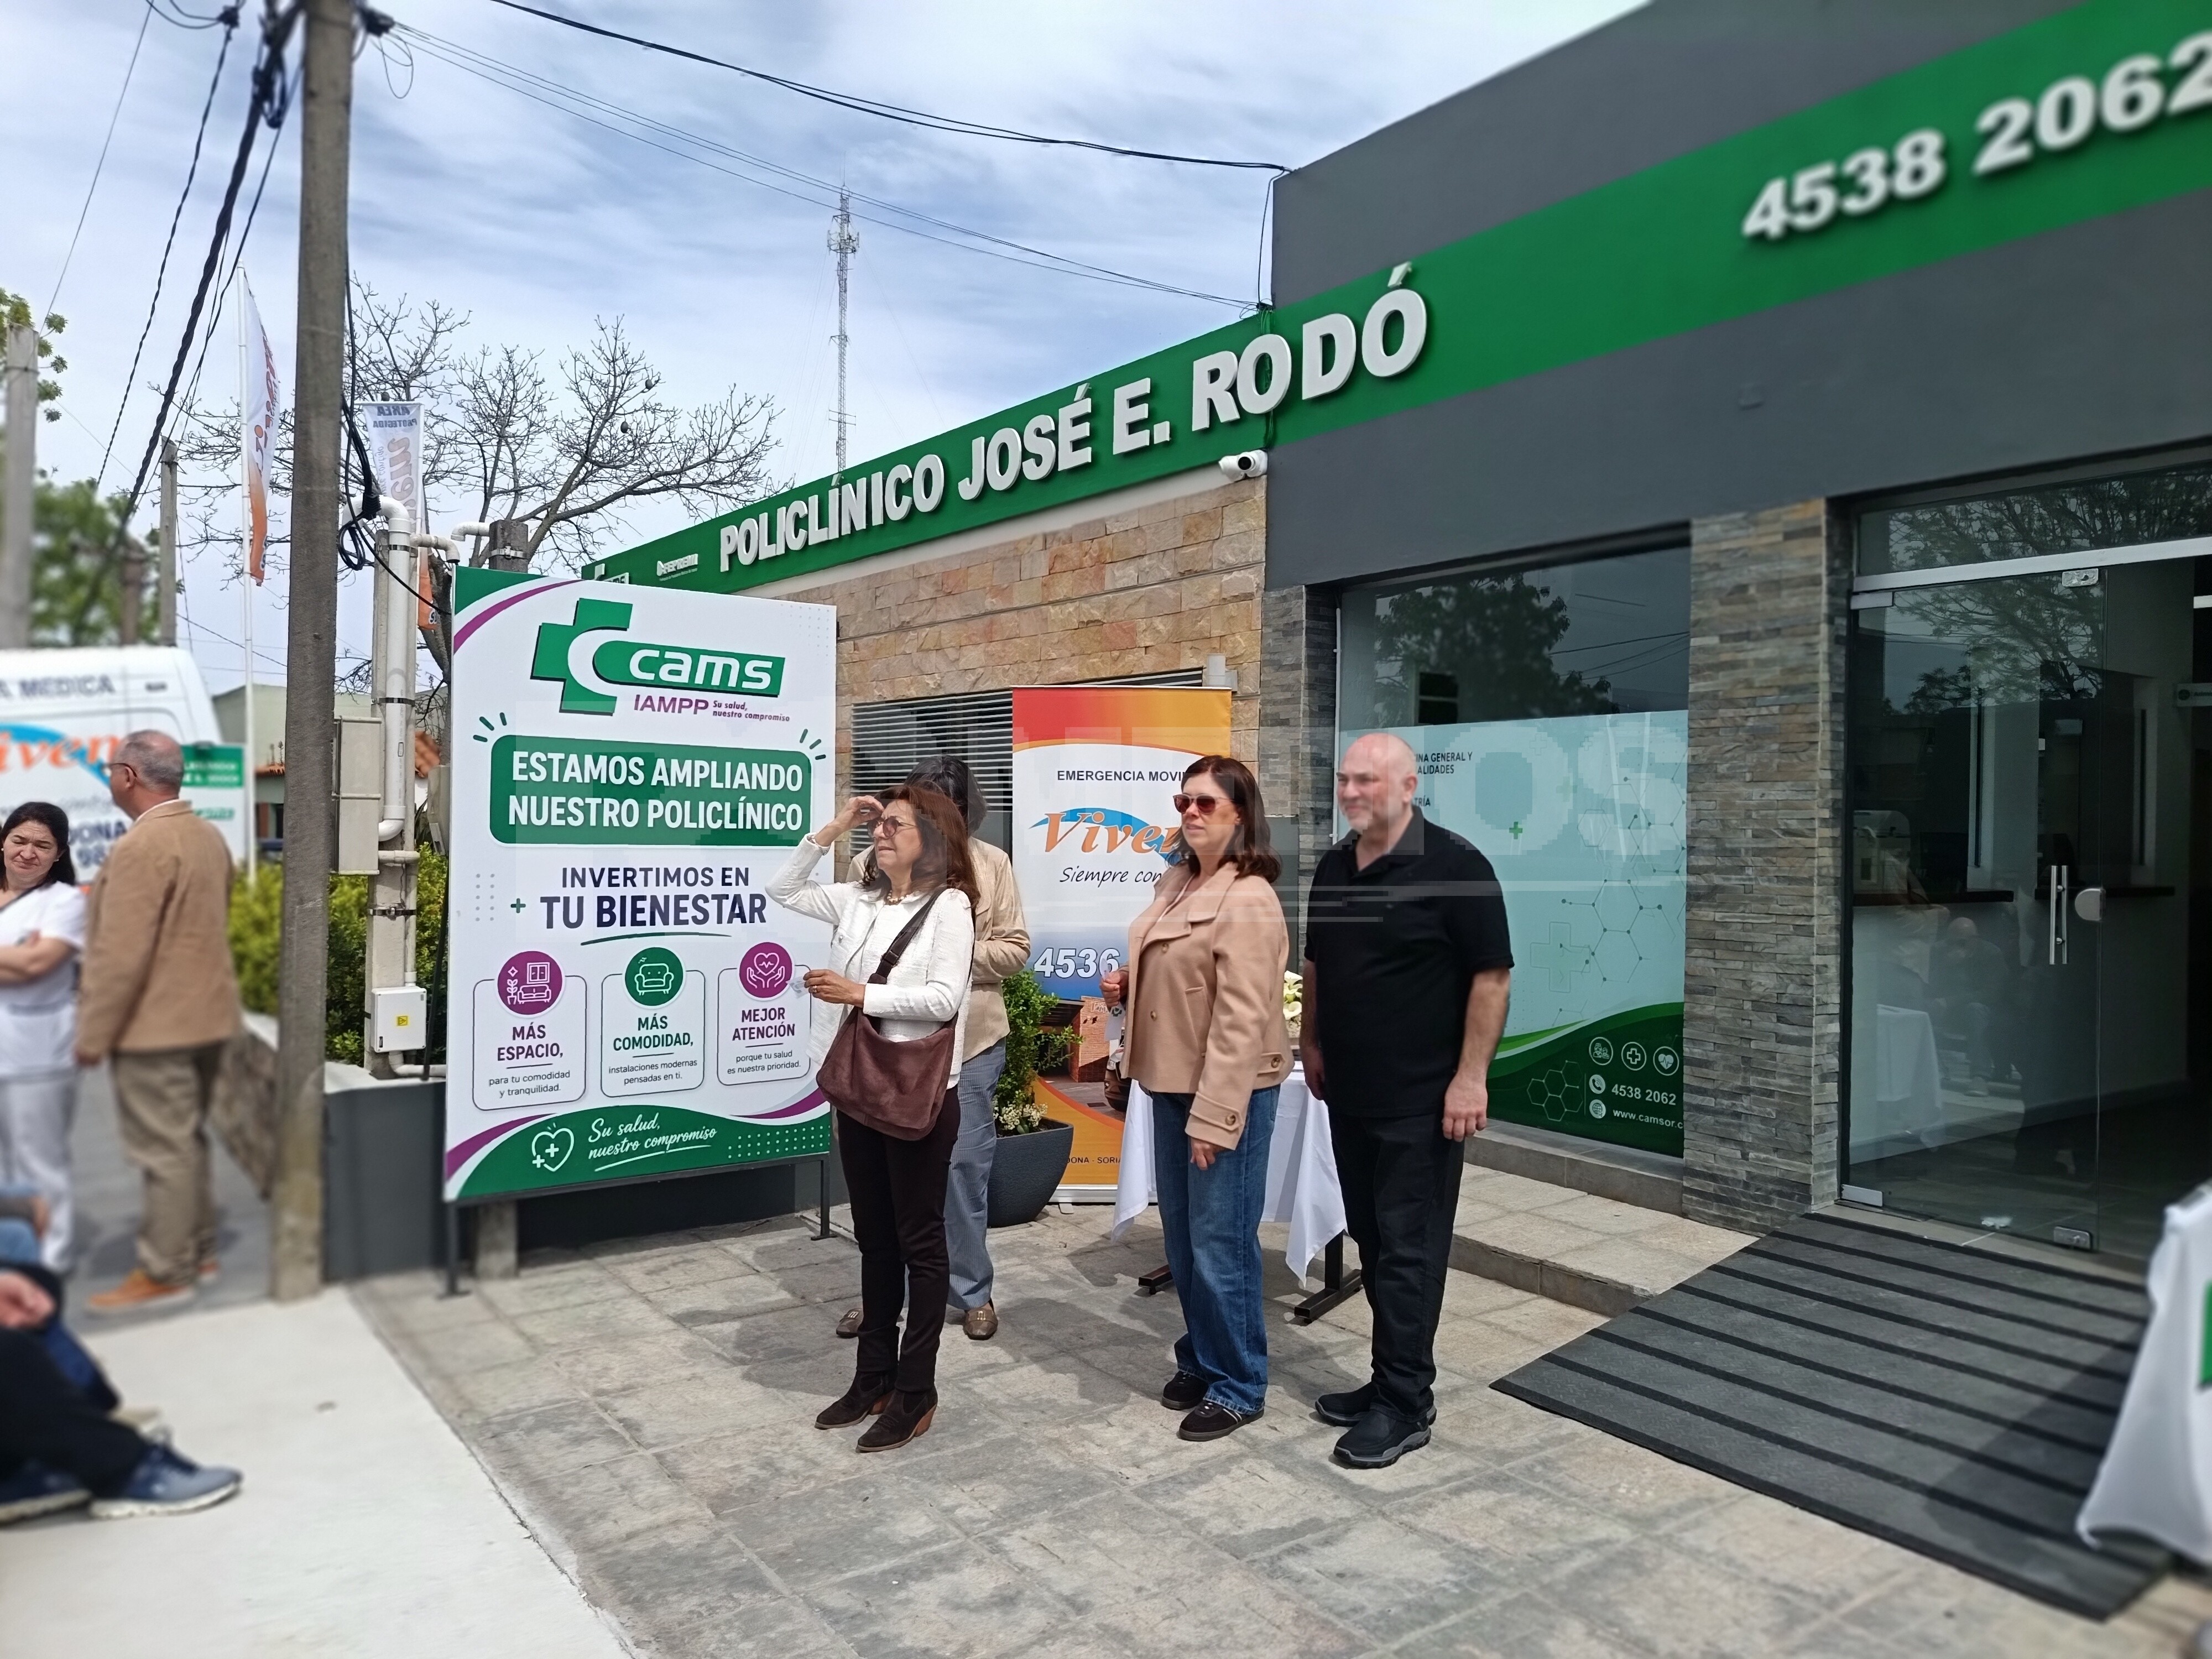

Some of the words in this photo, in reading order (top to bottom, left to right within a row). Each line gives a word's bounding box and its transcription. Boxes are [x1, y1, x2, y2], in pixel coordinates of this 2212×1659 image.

[1742, 128, 1948, 240] 4538
[1971, 30, 2212, 177] 2062
[720, 453, 945, 572] POLICLÍNICO
[958, 382, 1092, 501] JOSÉ
[1113, 378, 1170, 456] E.
[1192, 262, 1428, 431] RODÓ
[629, 648, 774, 691] cams
[634, 694, 709, 714] IAMPP
[713, 700, 722, 708] Su
[724, 701, 748, 711] salud,
[713, 710, 742, 718] nuestro
[745, 712, 790, 722] compromiso
[1416, 753, 1430, 763] INA
[1431, 752, 1466, 762] GENERAL
[1467, 751, 1473, 761] Y
[513, 750, 645, 786] ESTAMOS
[651, 758, 803, 792] AMPLIANDO
[1057, 770, 1145, 782] EMERGENCIA
[1149, 771, 1183, 781] MOVI
[1417, 764, 1454, 775] ALIDADES
[1415, 795, 1431, 807] TRÍA
[509, 795, 640, 828] NUESTRO
[647, 796, 803, 831] POLICLÍNICO
[562, 867, 714, 888] INVERTIMOS
[721, 867, 749, 886] EN
[1060, 865, 1129, 888] Siempre
[1134, 871, 1162, 883] con
[540, 895, 585, 929] TU
[596, 893, 767, 928] BIENESTAR
[1034, 947, 1120, 978] 4536
[638, 1013, 668, 1031] MÁS
[741, 1007, 785, 1023] MEJOR
[512, 1021, 546, 1041] MÁS
[732, 1021, 795, 1041] ATENCIÓN
[613, 1032, 693, 1051] COMODIDAD,
[497, 1042, 564, 1061] ESPACIO,
[735, 1053, 763, 1064] porque
[774, 1050, 792, 1058] salud
[608, 1063, 659, 1074] instalaciones
[660, 1060, 697, 1069] modernas
[738, 1065, 765, 1073] nuestra
[767, 1060, 801, 1072] prioridad.
[489, 1077, 509, 1087] para
[523, 1070, 571, 1082] comodidad
[624, 1074, 661, 1086] pensadas
[499, 1090, 505, 1099] y
[1611, 1083, 1641, 1099] 4538
[1645, 1089, 1677, 1105] 2062
[588, 1117, 614, 1143] Su
[617, 1112, 661, 1136] salud,
[1613, 1109, 1683, 1129] www.camsor.c
[588, 1136, 641, 1160] nuestro
[644, 1125, 718, 1151] compromiso
